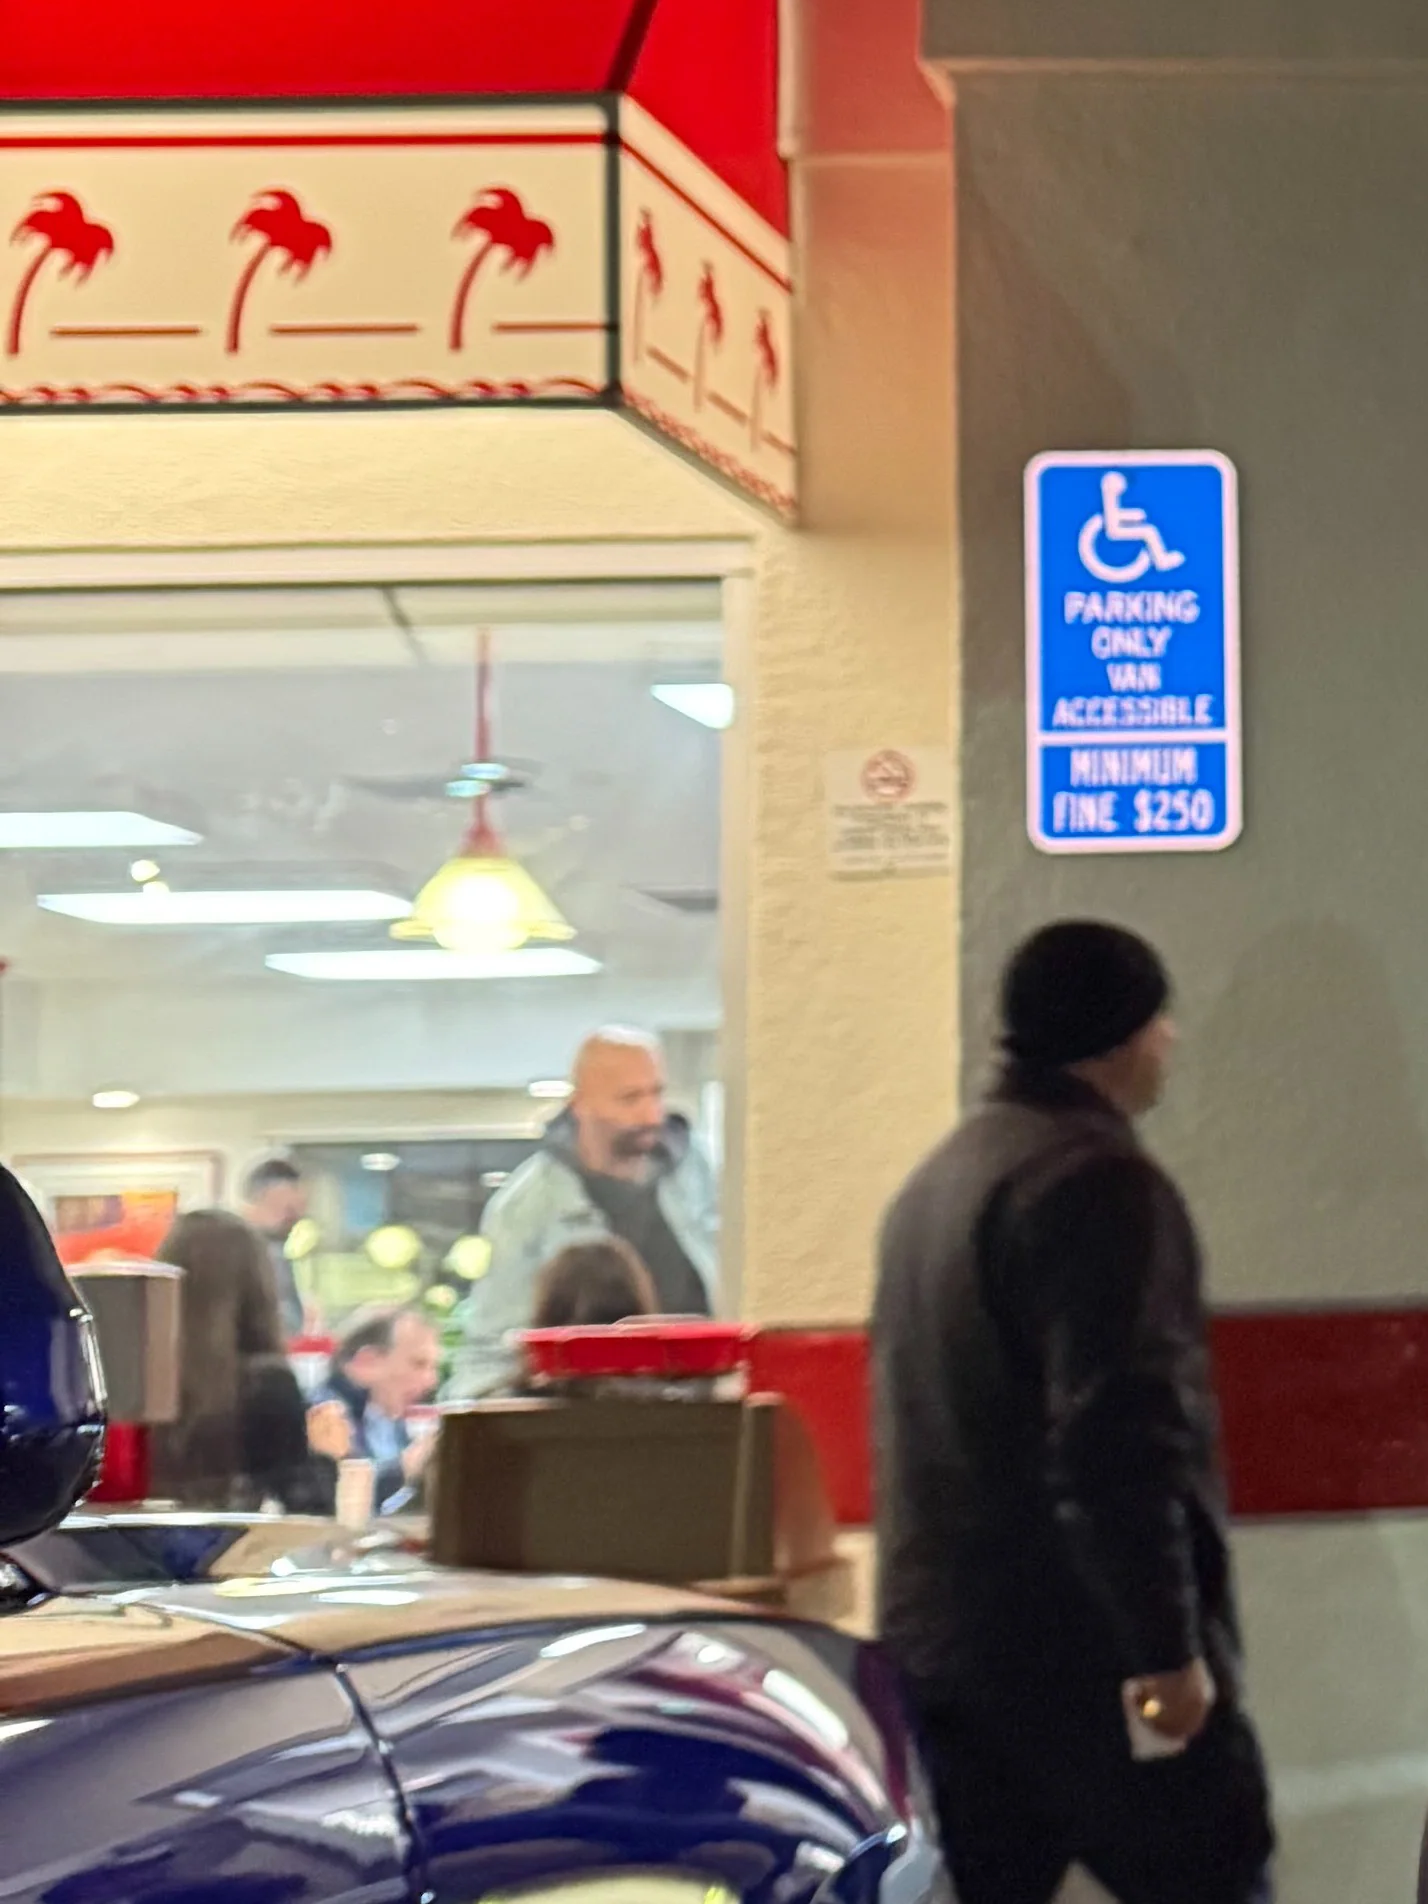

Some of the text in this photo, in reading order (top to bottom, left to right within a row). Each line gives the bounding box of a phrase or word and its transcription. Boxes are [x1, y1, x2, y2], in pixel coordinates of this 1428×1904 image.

[1064, 591, 1200, 625] PARKING
[1091, 626, 1172, 660] ONLY
[1106, 662, 1162, 693] VAN
[1052, 694, 1214, 728] ACCESSIBLE
[1069, 746, 1199, 787] MINIMUM
[1052, 788, 1215, 833] FINE $250
